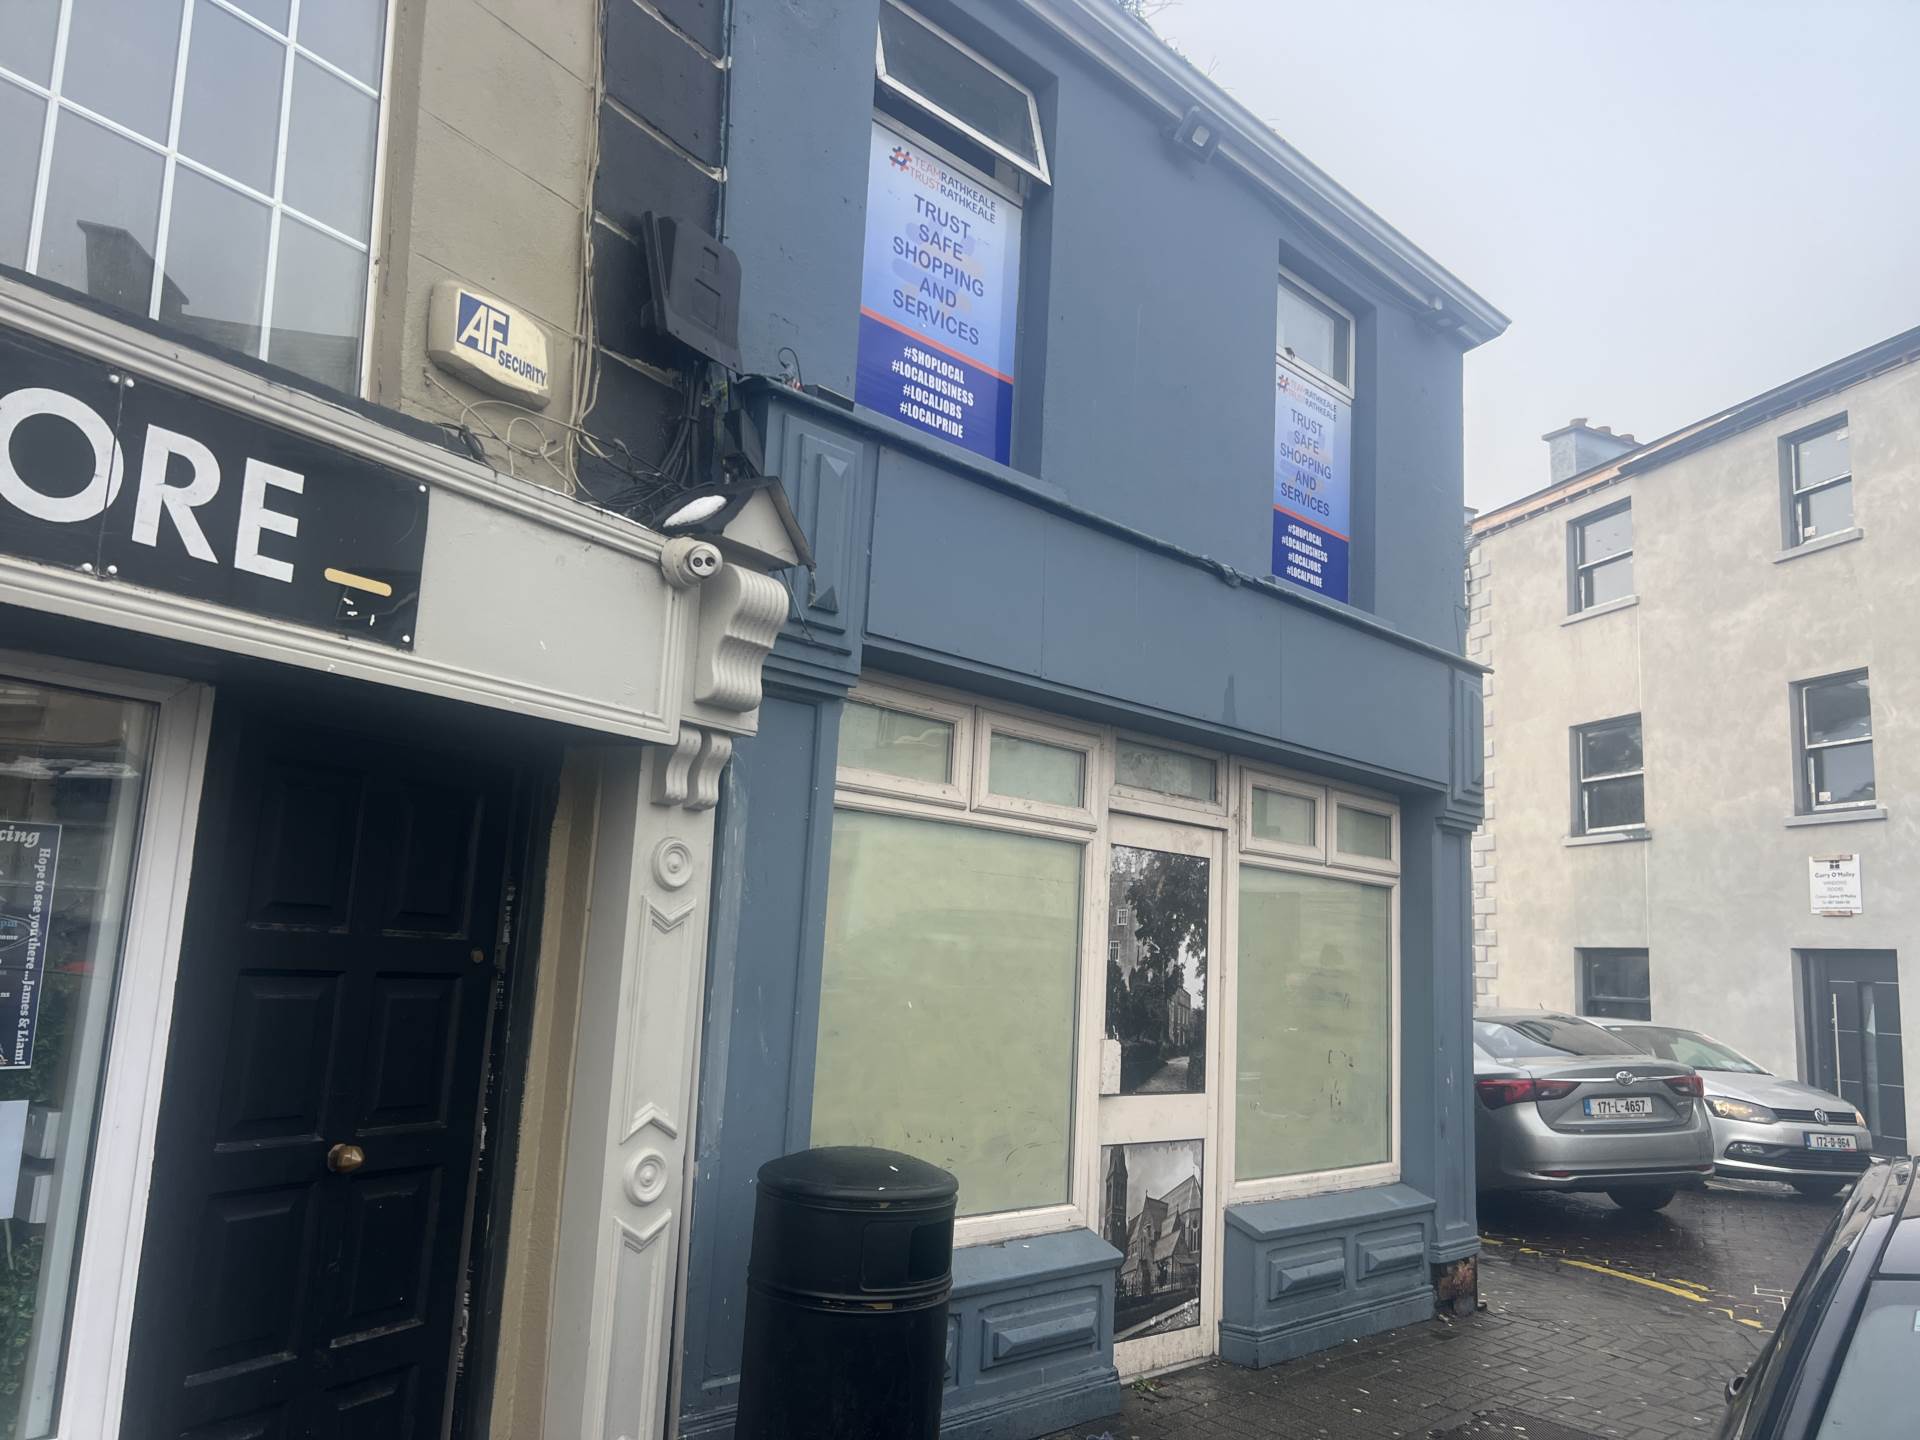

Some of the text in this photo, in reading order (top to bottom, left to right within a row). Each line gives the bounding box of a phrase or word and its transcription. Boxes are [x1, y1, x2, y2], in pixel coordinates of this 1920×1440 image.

[914, 194, 971, 239] TRUST
[918, 223, 963, 262] SAFE
[892, 236, 984, 297] SHOPPING
[919, 277, 957, 308] AND
[892, 289, 980, 346] SERVICES
[458, 304, 547, 386] AF SECURITY
[903, 346, 965, 385] #SHOPLOCAL
[891, 360, 974, 406] #LOCALBUSINESS
[903, 384, 962, 420] #LOCALJOBS
[899, 401, 964, 439] #LOCALPRIDE
[1291, 408, 1323, 437] TRUST
[1294, 431, 1320, 454] SAFE
[1280, 442, 1332, 480] SHOPPING
[0, 387, 305, 583] ORE
[1295, 470, 1317, 491] AND
[1280, 483, 1330, 517] SERVICES
[1281, 536, 1328, 563] #LOCALBUSINESS
[1287, 524, 1322, 547] #SHOPLOCAL
[1286, 565, 1323, 588] #LOCALPRIDE
[1287, 552, 1322, 574] #LOCALJOBS
[34, 848, 51, 879] Hope
[34, 881, 45, 892] to
[33, 894, 43, 913] see
[28, 914, 41, 936] you
[18, 1018, 30, 1028] &
[14, 1030, 29, 1065] Liam!
[1597, 1100, 1645, 1114] 171-L-4657
